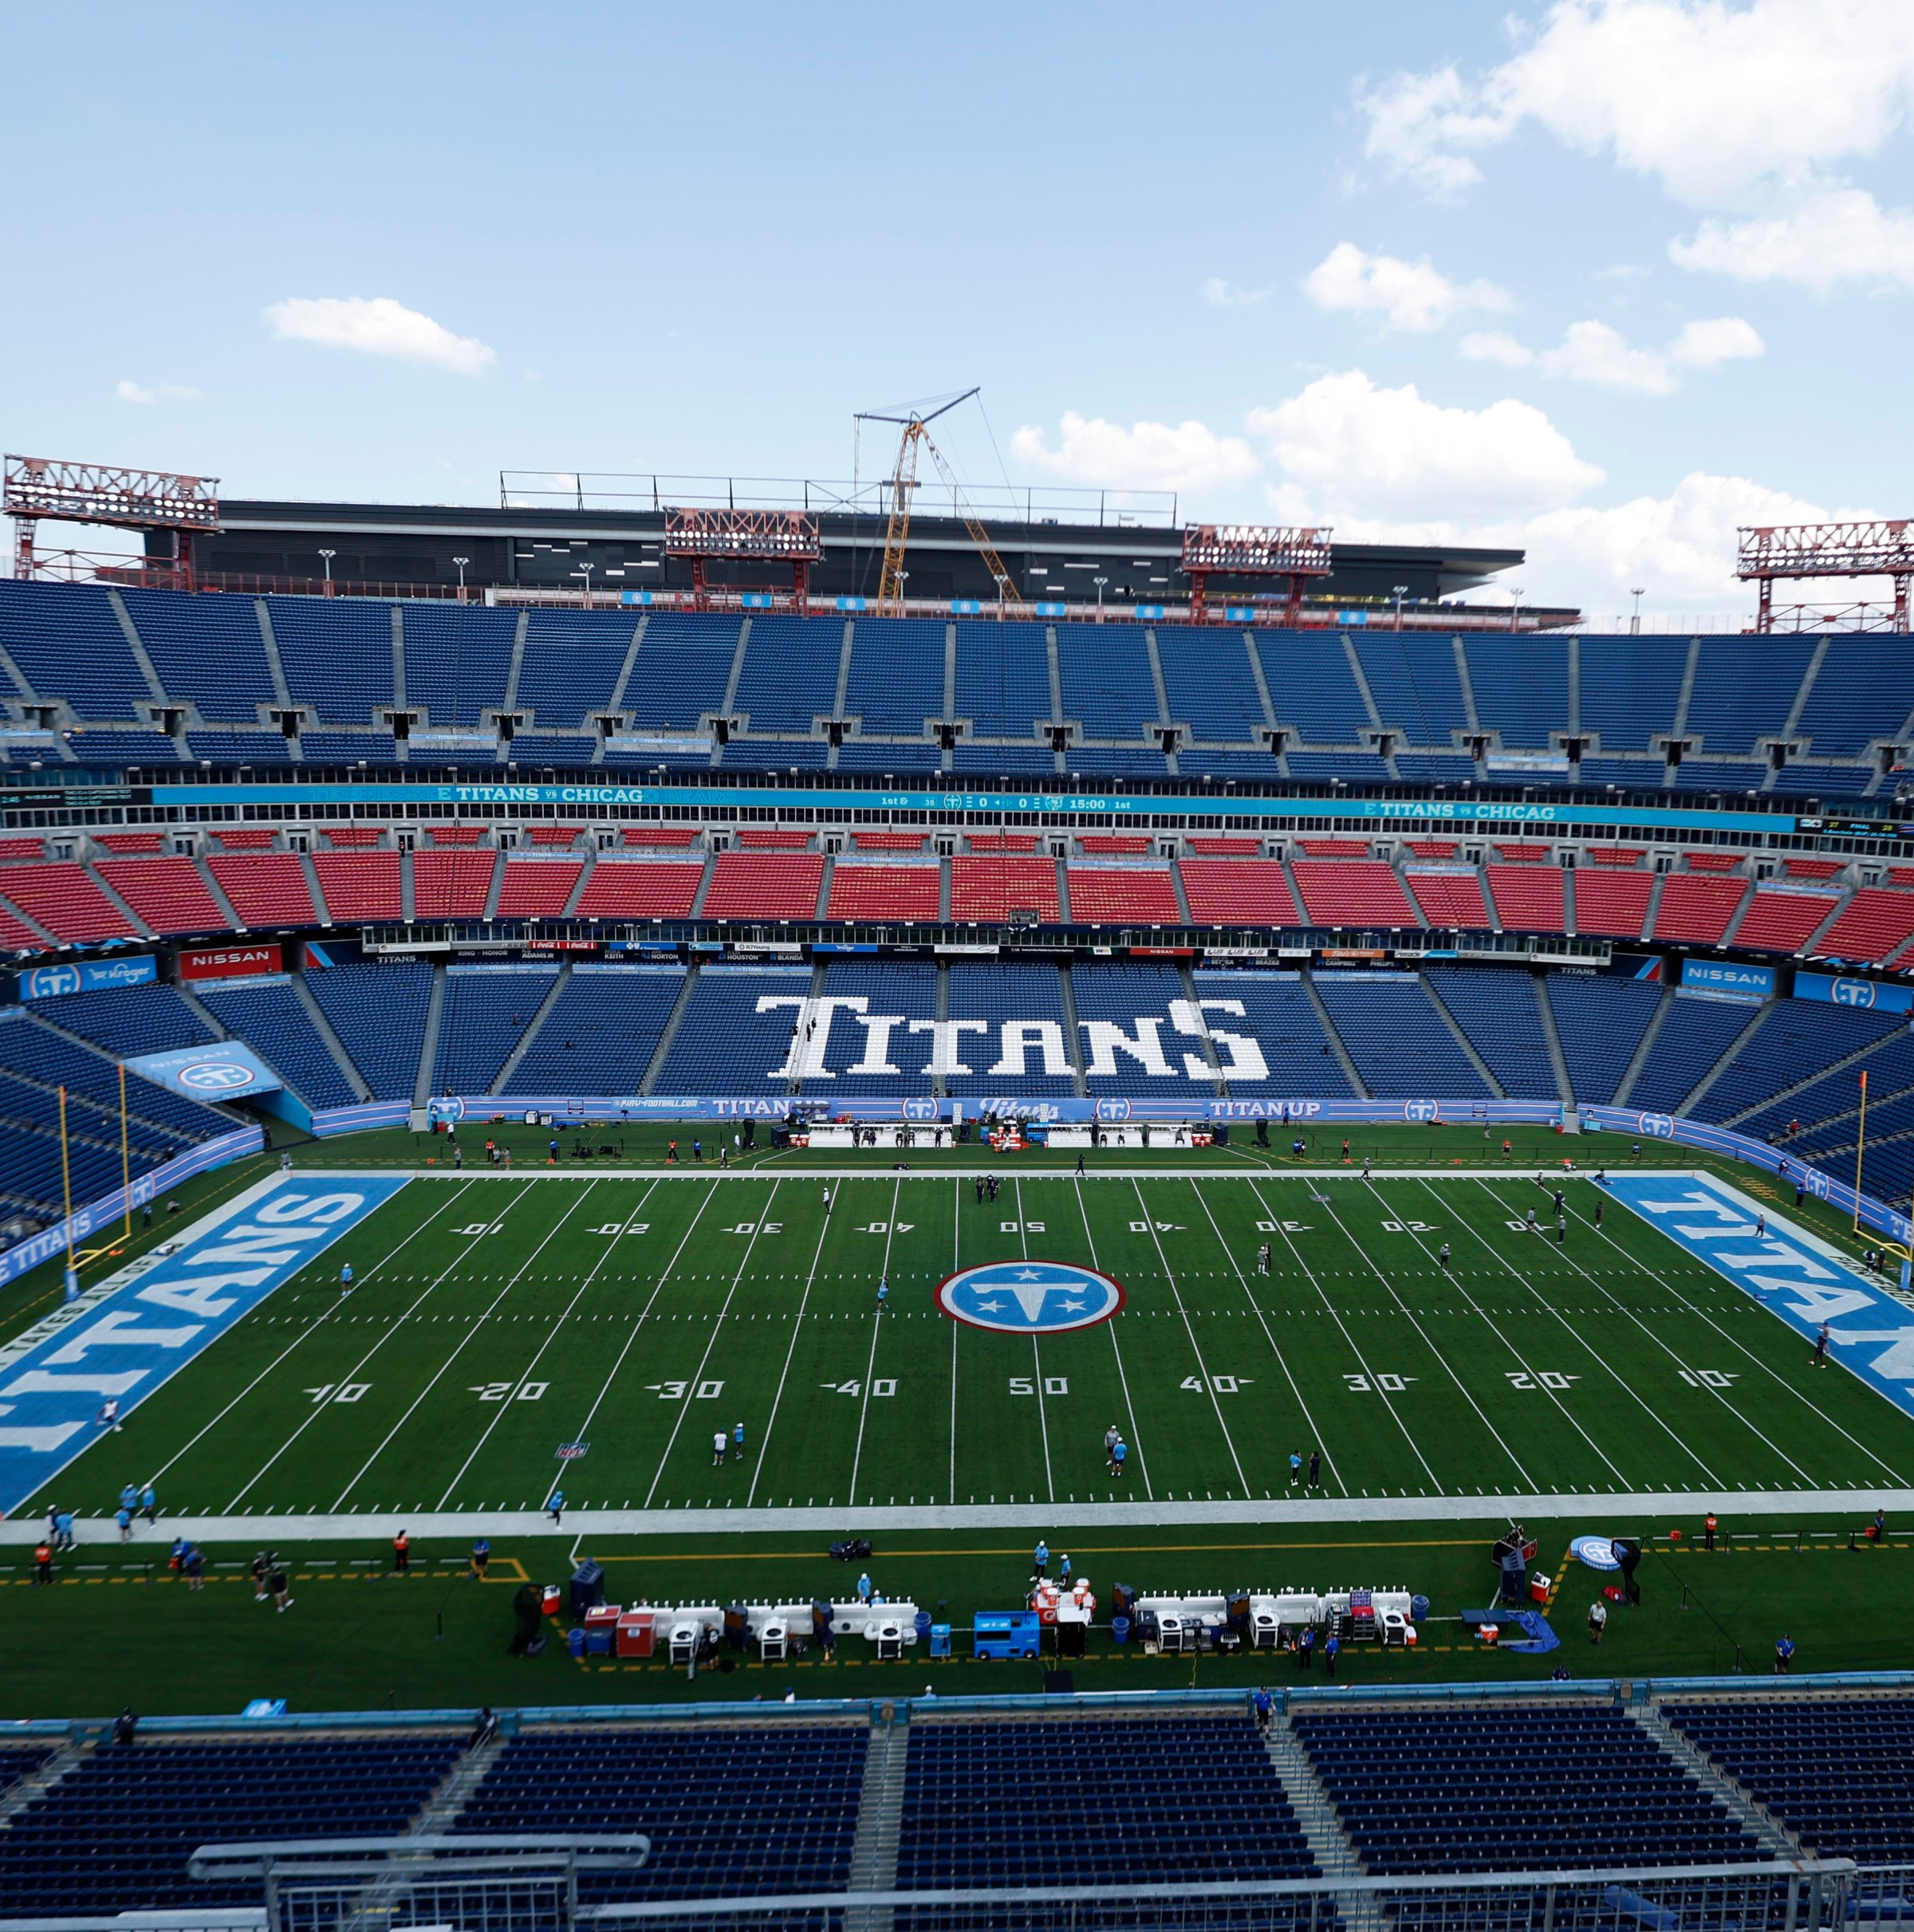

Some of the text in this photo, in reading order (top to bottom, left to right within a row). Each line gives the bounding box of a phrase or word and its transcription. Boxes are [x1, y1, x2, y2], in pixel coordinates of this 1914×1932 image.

[455, 787, 539, 801] TITANS
[979, 797, 987, 807] 0
[1019, 798, 1027, 808] 0
[1070, 800, 1105, 809] 15:00
[1380, 803, 1454, 817] TITANS
[192, 950, 270, 967] NISSAN
[376, 955, 417, 964] TITANS
[108, 962, 151, 983] Kroger
[1688, 967, 1767, 986] NISSAN
[754, 995, 1271, 1081] TITANS
[149, 1050, 231, 1068] NISSAN
[223, 1087, 263, 1100] NISSAN
[713, 1100, 789, 1116] TITAN
[1209, 1102, 1321, 1117] TITAN UP
[13, 1211, 93, 1271] TITANS
[2, 1306, 87, 1353] TAKES
[78, 1277, 130, 1302] ALL
[1009, 1377, 1069, 1395] 50
[1180, 1375, 1239, 1394] 40
[1342, 1373, 1408, 1391] 30
[1504, 1372, 1572, 1390] 20
[1676, 1370, 1734, 1387] 10
[311, 1383, 374, 1403] 10
[478, 1382, 550, 1401] 20
[657, 1380, 726, 1400] 30
[837, 1379, 899, 1398] 40
